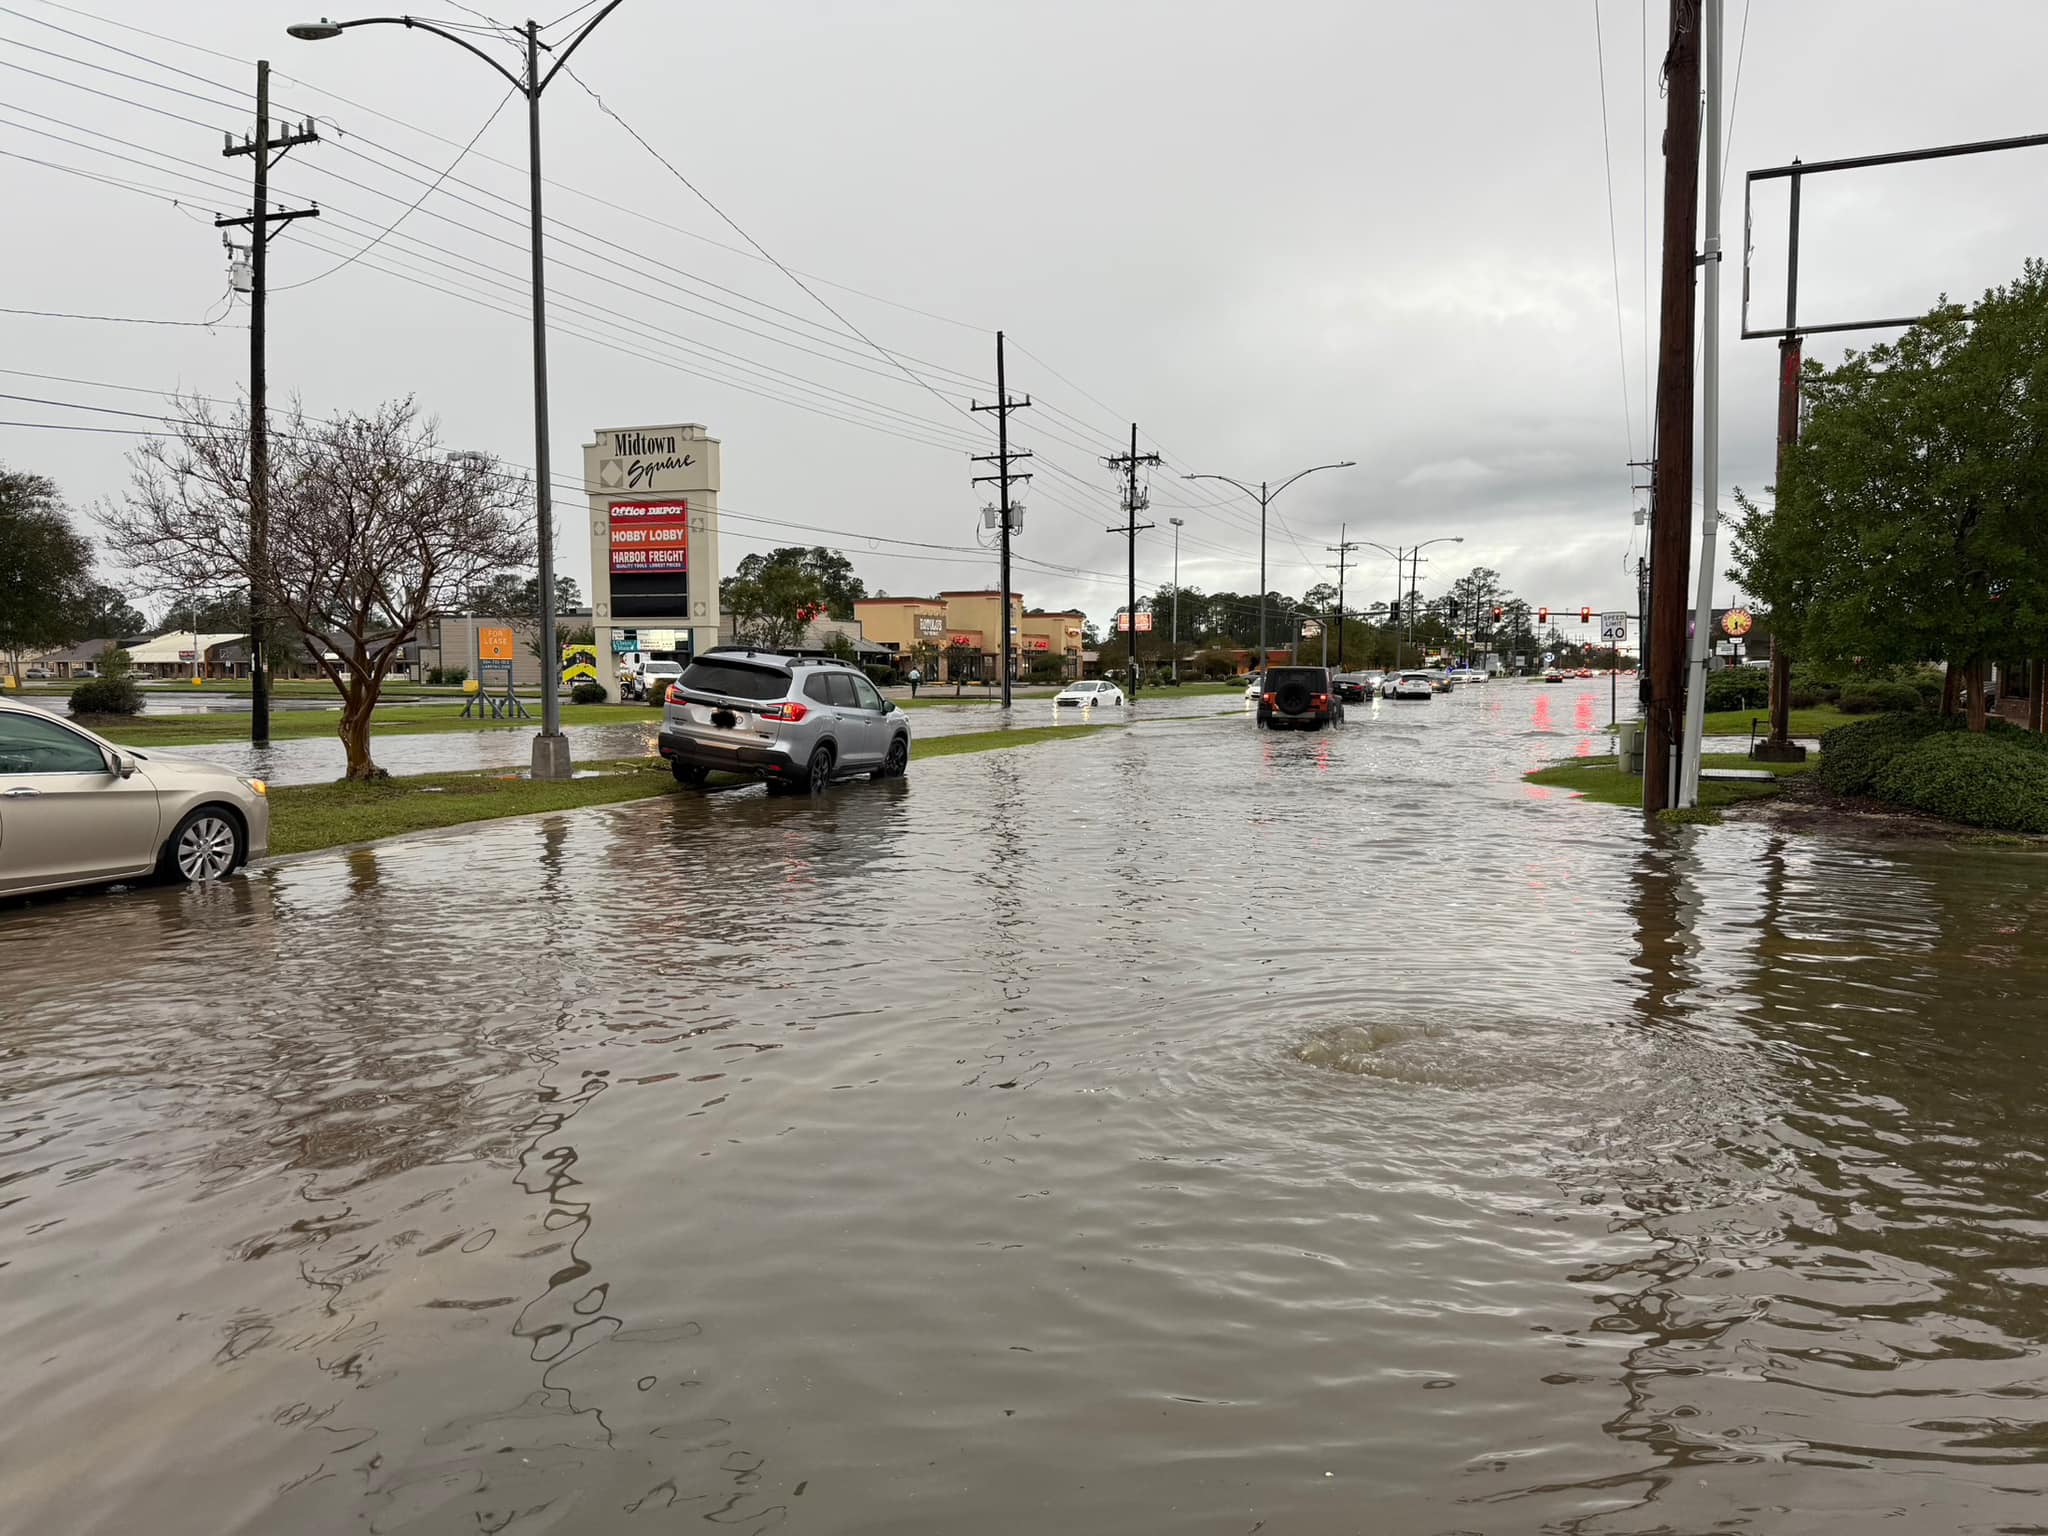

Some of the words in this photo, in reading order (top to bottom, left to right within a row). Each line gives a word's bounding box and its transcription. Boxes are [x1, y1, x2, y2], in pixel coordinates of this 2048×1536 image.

[615, 432, 676, 457] Midtown
[627, 454, 696, 489] Square
[611, 507, 646, 516] Office
[611, 530, 647, 542] HOBBY
[649, 529, 684, 541] LOBBY
[612, 551, 646, 563] HARBOR
[649, 550, 684, 562] FREIGHT
[1604, 627, 1624, 639] 40
